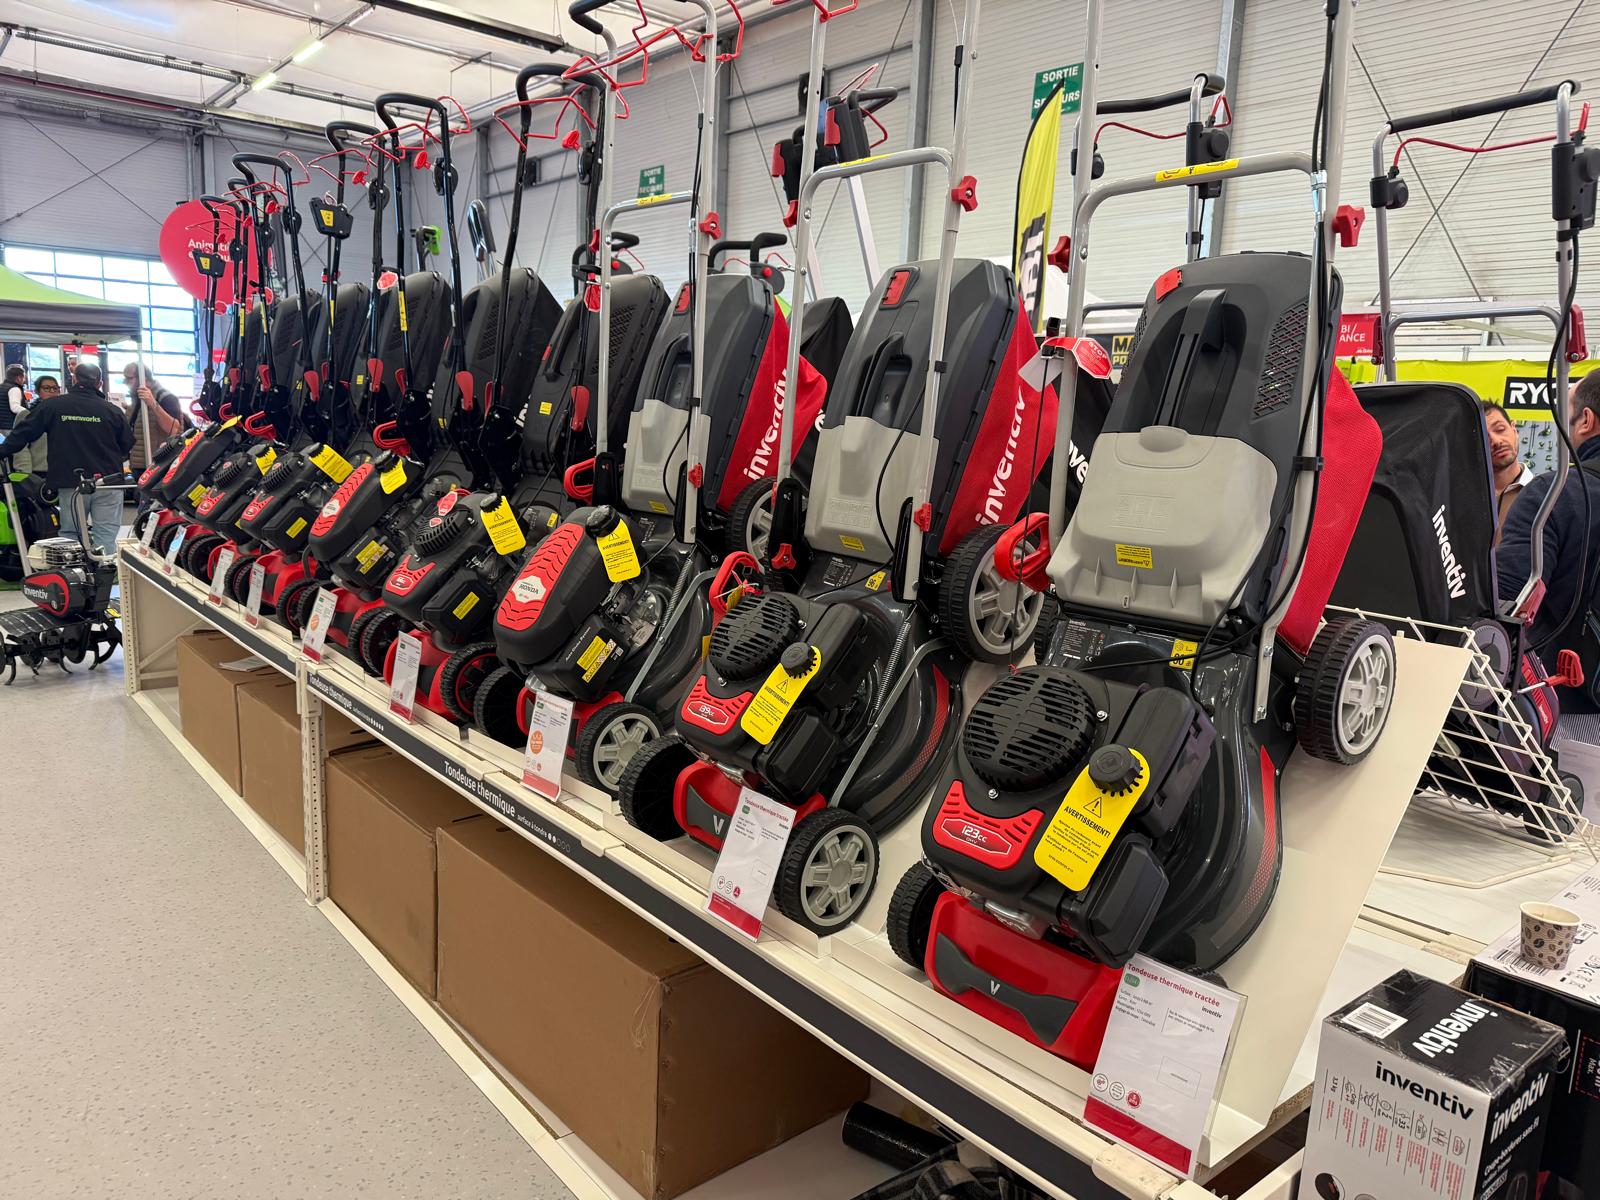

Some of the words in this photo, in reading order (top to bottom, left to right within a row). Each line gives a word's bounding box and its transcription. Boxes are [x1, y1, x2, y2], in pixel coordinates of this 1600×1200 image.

[1042, 66, 1078, 83] SORTIE
[1089, 342, 1107, 359] STOP
[61, 414, 101, 423] greenworks
[1432, 504, 1466, 599] inventiv
[24, 584, 48, 600] inventiv
[519, 584, 539, 595] HONDA
[444, 760, 476, 792] Tondeuse
[477, 782, 515, 817] thermique
[517, 814, 531, 826] surface
[534, 825, 548, 839] tondre
[961, 824, 987, 843] 123cc
[1064, 806, 1111, 838] AVERTISSEMENT!
[1127, 963, 1159, 981] Tondeuse
[1159, 977, 1194, 997] thermique
[1195, 991, 1220, 1007] tractée
[1202, 1006, 1222, 1018] inventiv
[1412, 1000, 1499, 1058] inventiv
[1376, 1060, 1474, 1120] inventiv
[1490, 1072, 1549, 1144] inventiv
